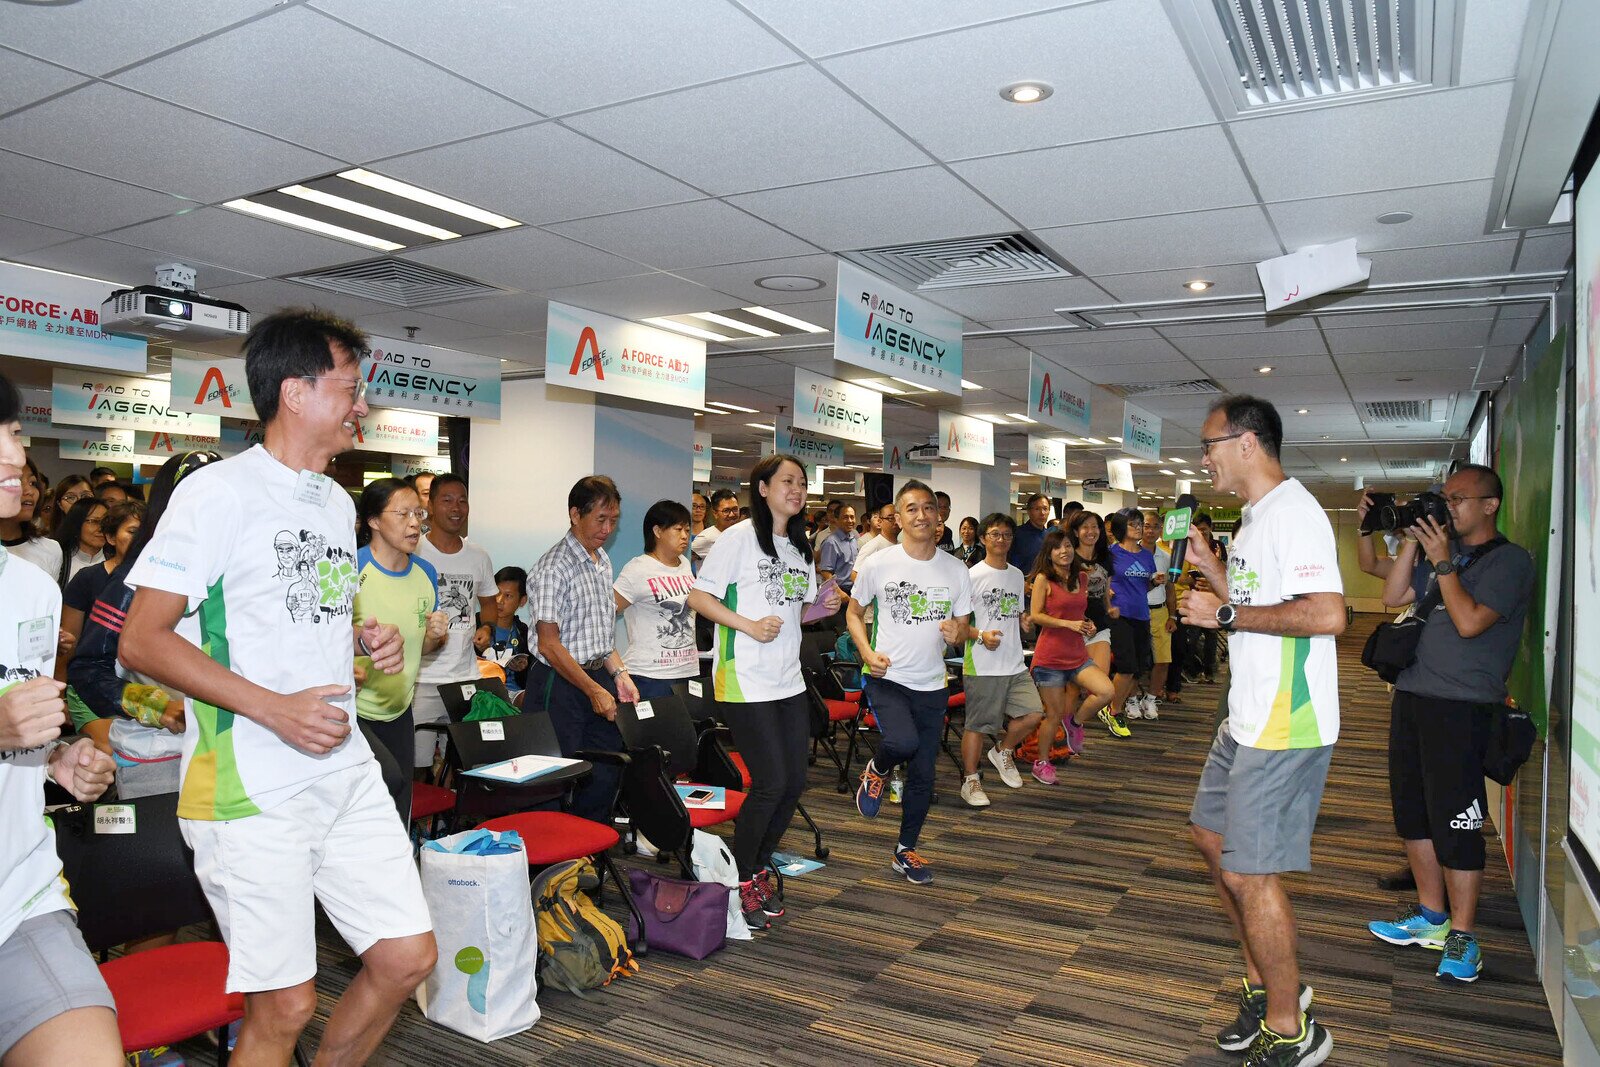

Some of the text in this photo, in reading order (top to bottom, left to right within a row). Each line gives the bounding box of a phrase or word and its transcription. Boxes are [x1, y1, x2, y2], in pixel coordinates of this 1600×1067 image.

[861, 291, 914, 324] ROAD TO
[621, 348, 629, 361] A
[412, 357, 431, 368] TO
[82, 382, 151, 398] ROAD TO
[1125, 570, 1149, 578] adidas
